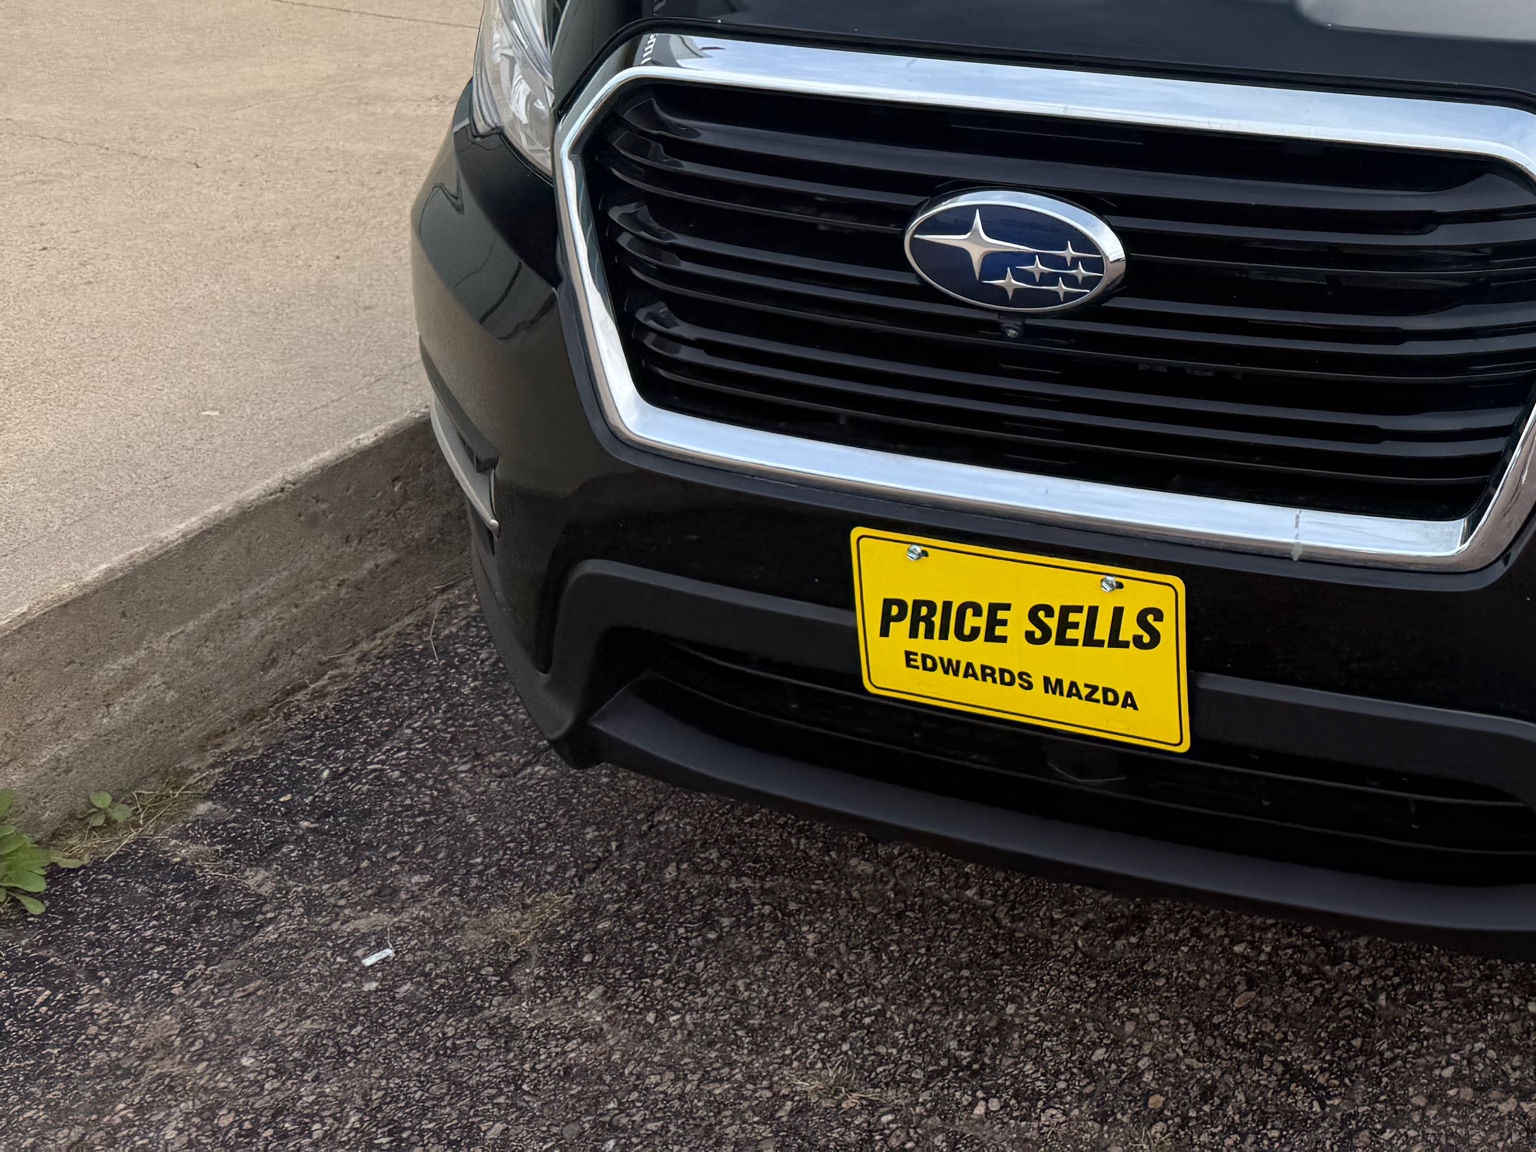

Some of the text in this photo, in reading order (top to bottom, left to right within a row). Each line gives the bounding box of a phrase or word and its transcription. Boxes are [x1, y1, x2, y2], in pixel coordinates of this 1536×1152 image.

[879, 598, 1164, 650] PRICE SELLS
[904, 649, 1139, 711] EDWARDS MAZDA
